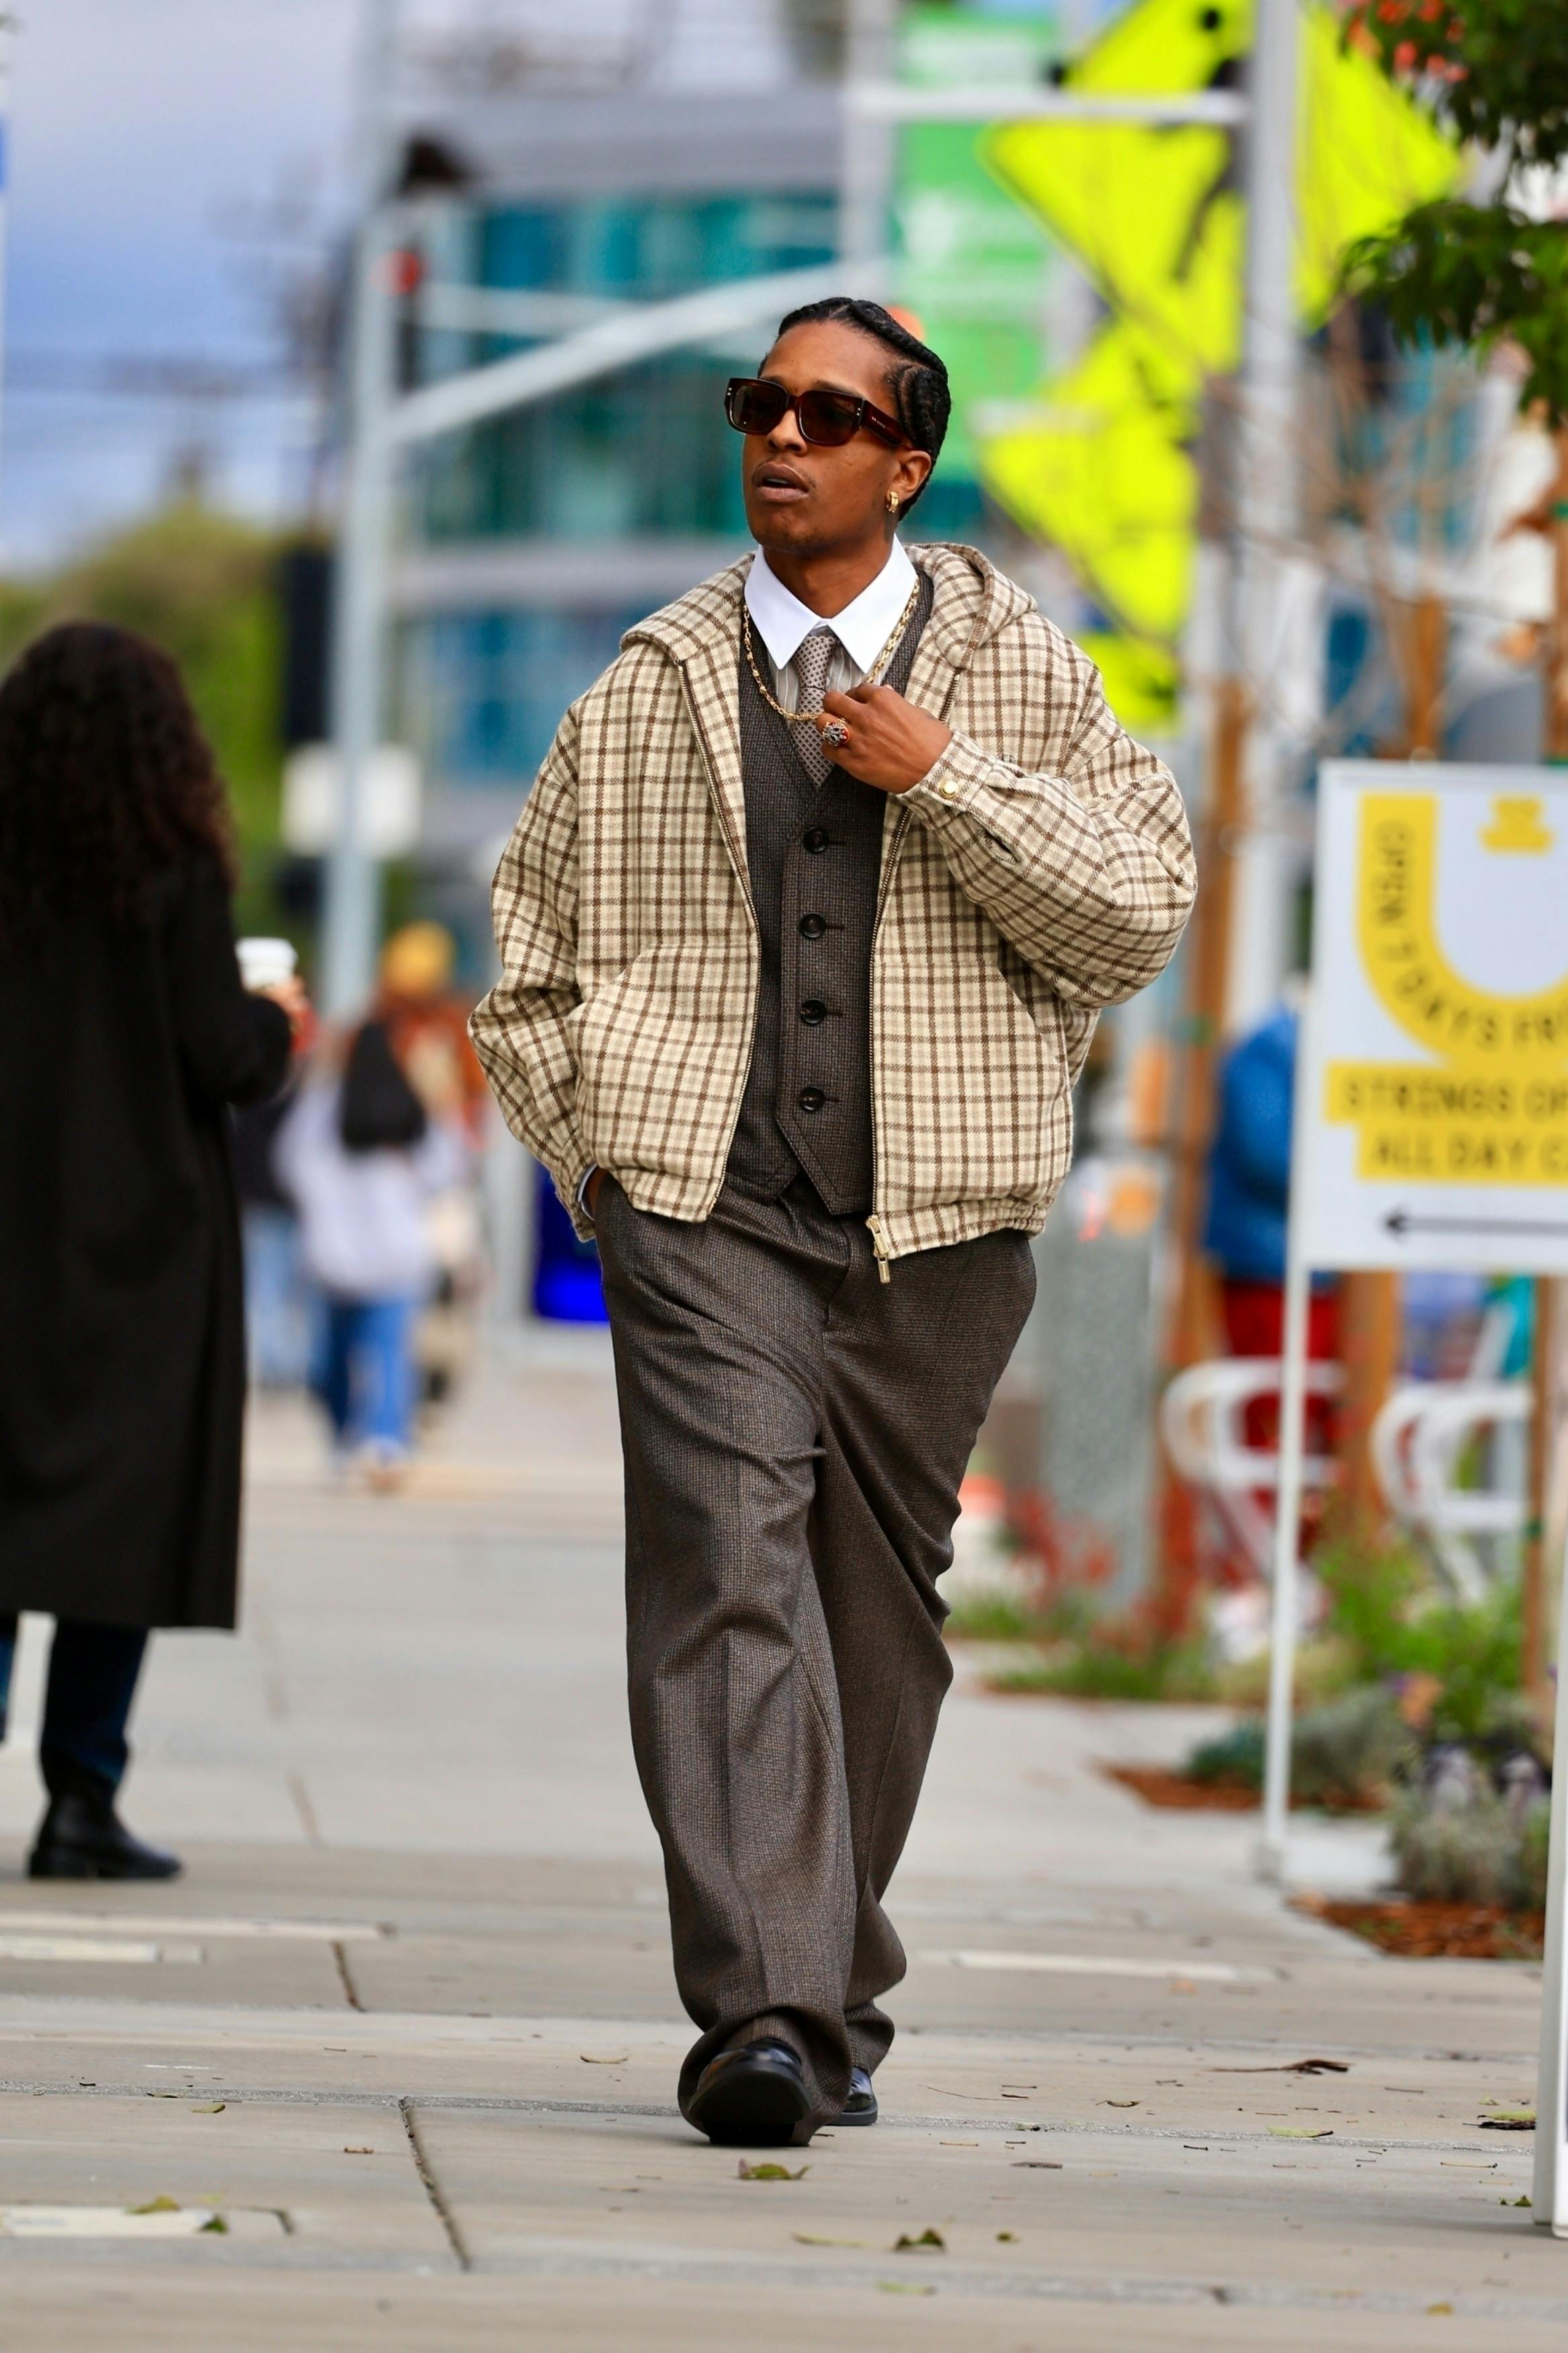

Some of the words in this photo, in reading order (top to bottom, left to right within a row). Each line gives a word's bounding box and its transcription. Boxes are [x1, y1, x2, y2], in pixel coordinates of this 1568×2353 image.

[1374, 820, 1414, 927] OPEN
[1393, 963, 1508, 1047] DAYS
[1512, 1003, 1568, 1047] FR
[1372, 1131, 1436, 1170] ALL
[1446, 1132, 1531, 1173] DAY
